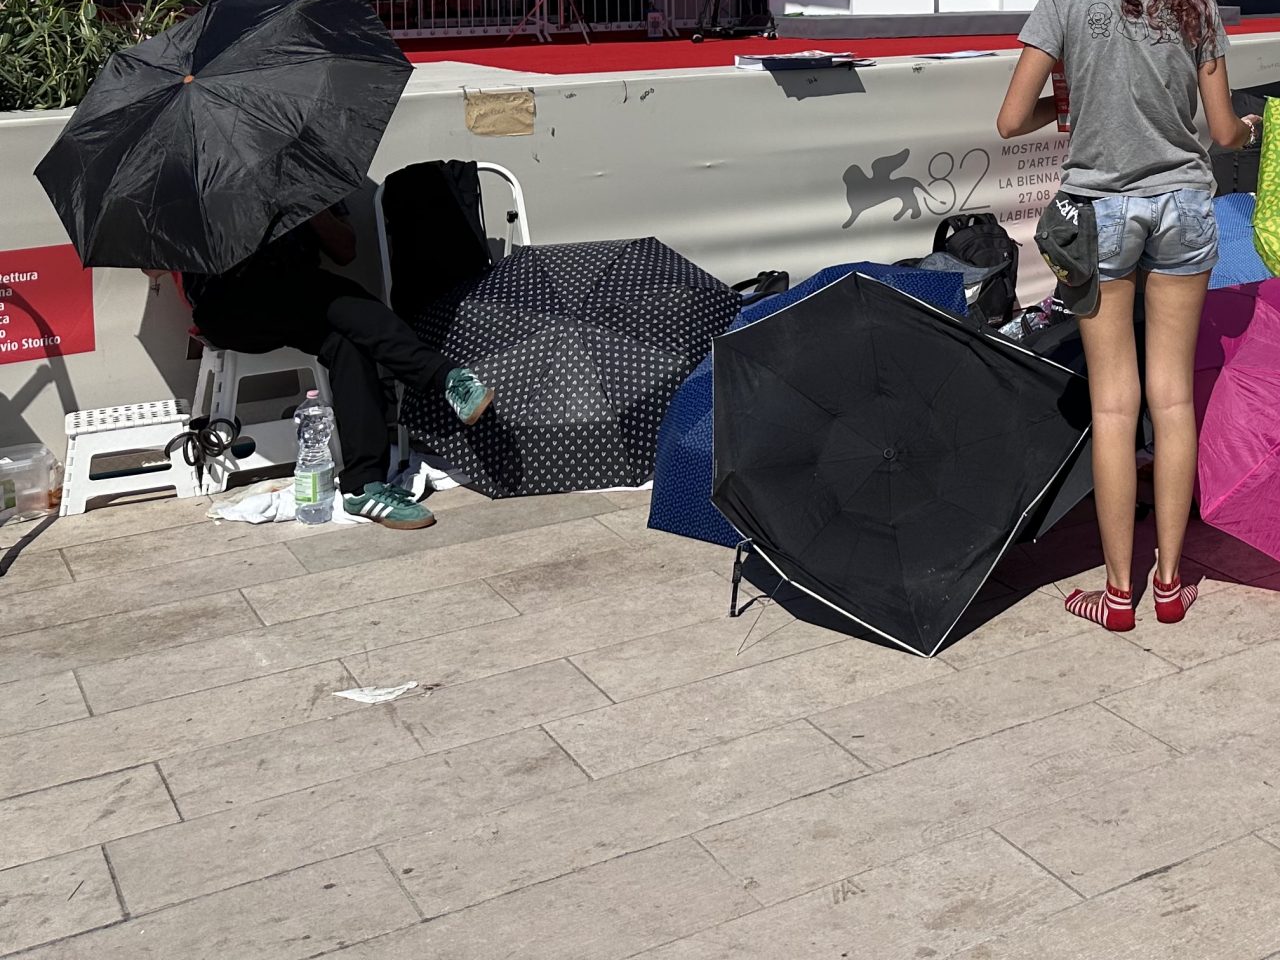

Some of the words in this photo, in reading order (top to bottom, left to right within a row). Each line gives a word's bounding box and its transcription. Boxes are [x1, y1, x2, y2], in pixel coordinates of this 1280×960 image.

[1001, 141, 1049, 157] MOSTRA
[1017, 155, 1058, 170] D'ARTE
[924, 147, 991, 216] 82
[999, 178, 1013, 190] LA
[1018, 190, 1051, 204] 27.08
[0, 339, 19, 352] vio
[22, 334, 61, 350] Storico
